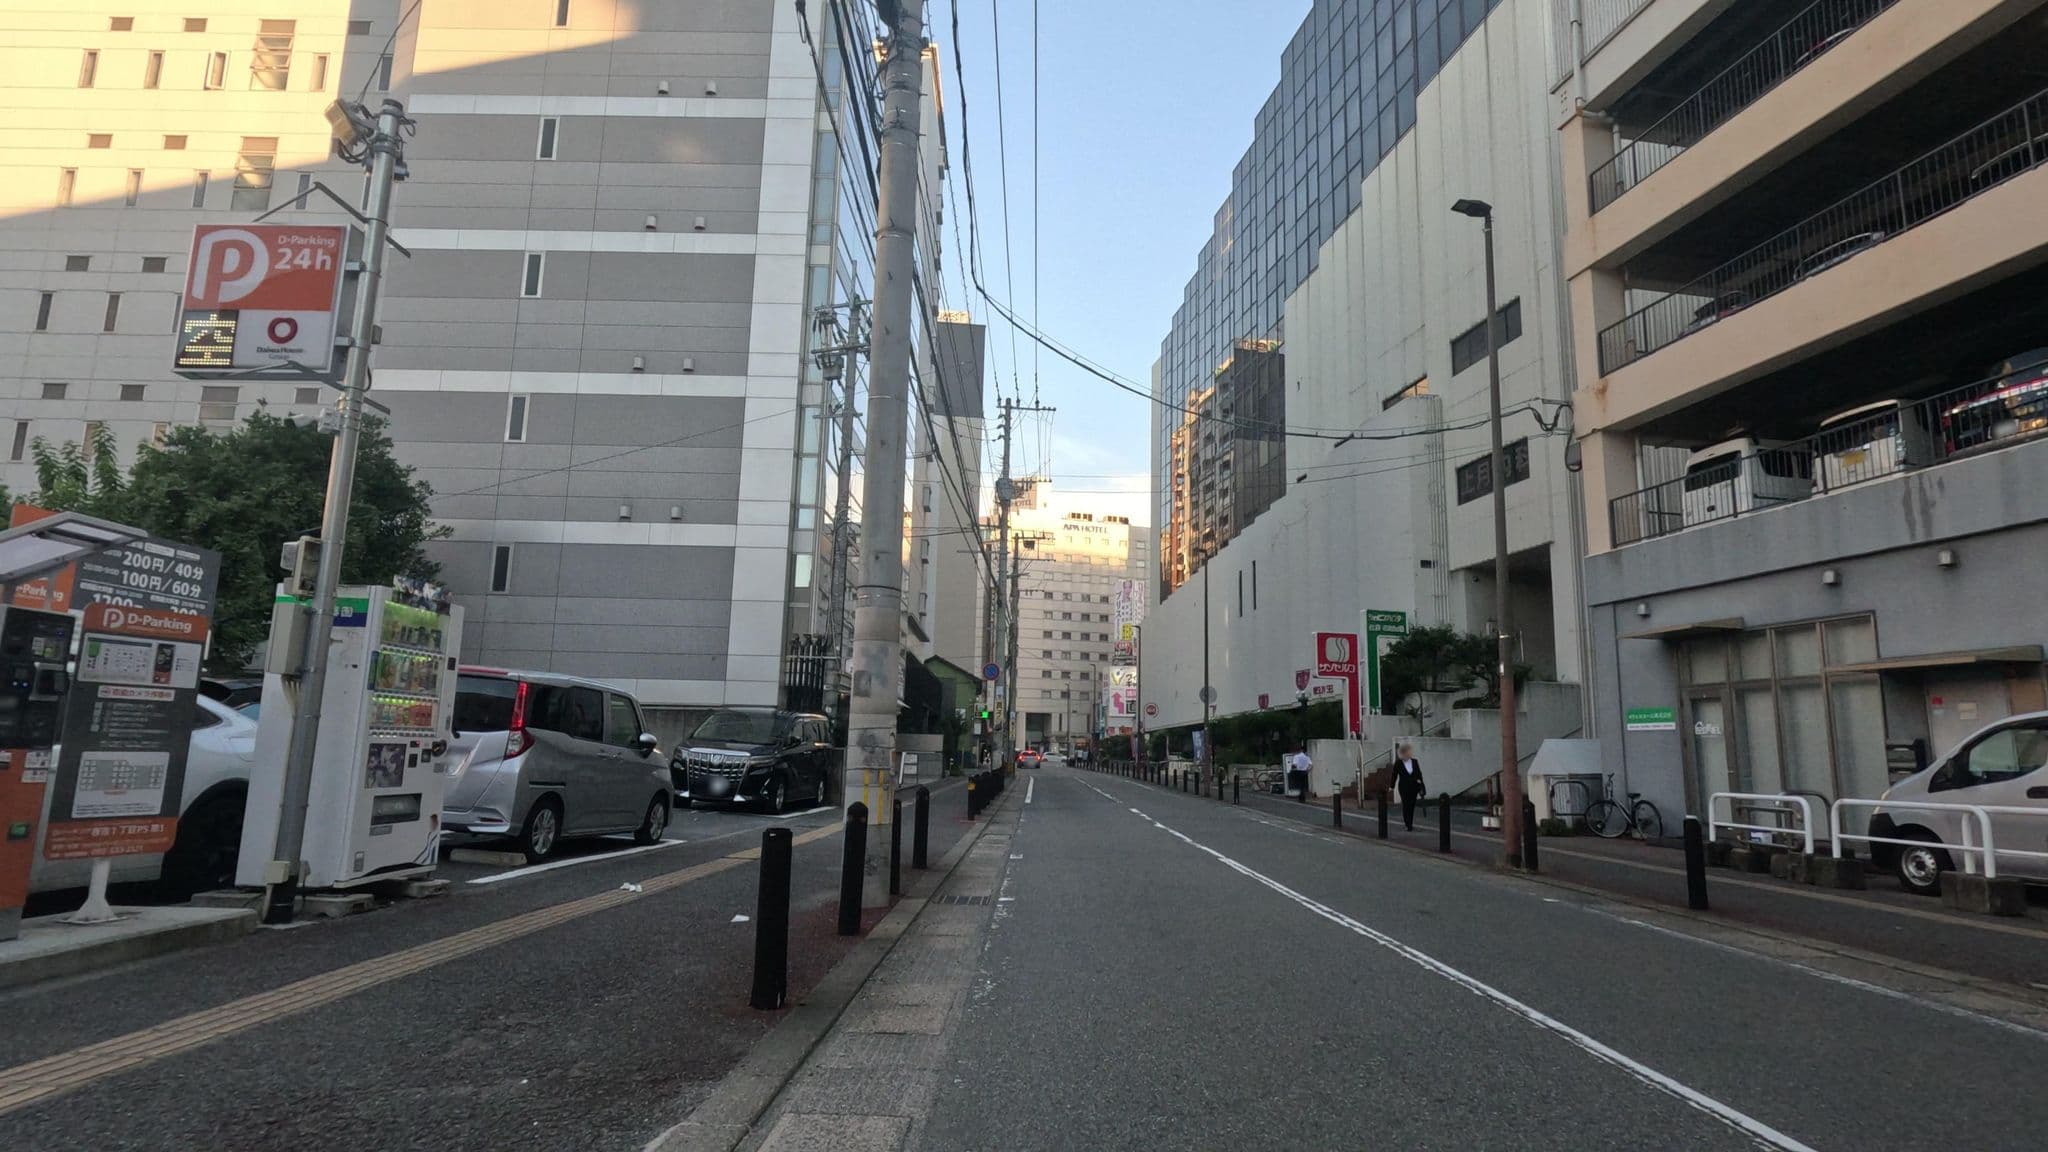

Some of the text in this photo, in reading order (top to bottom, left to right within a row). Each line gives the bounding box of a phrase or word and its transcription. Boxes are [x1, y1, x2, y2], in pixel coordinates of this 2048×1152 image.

[277, 235, 337, 248] D-Parking
[274, 247, 332, 271] 24h
[179, 313, 237, 366] 空
[1063, 523, 1109, 534] APA HOTEL
[127, 613, 192, 633] D-Parking
[1319, 663, 1356, 674] サンセルコ
